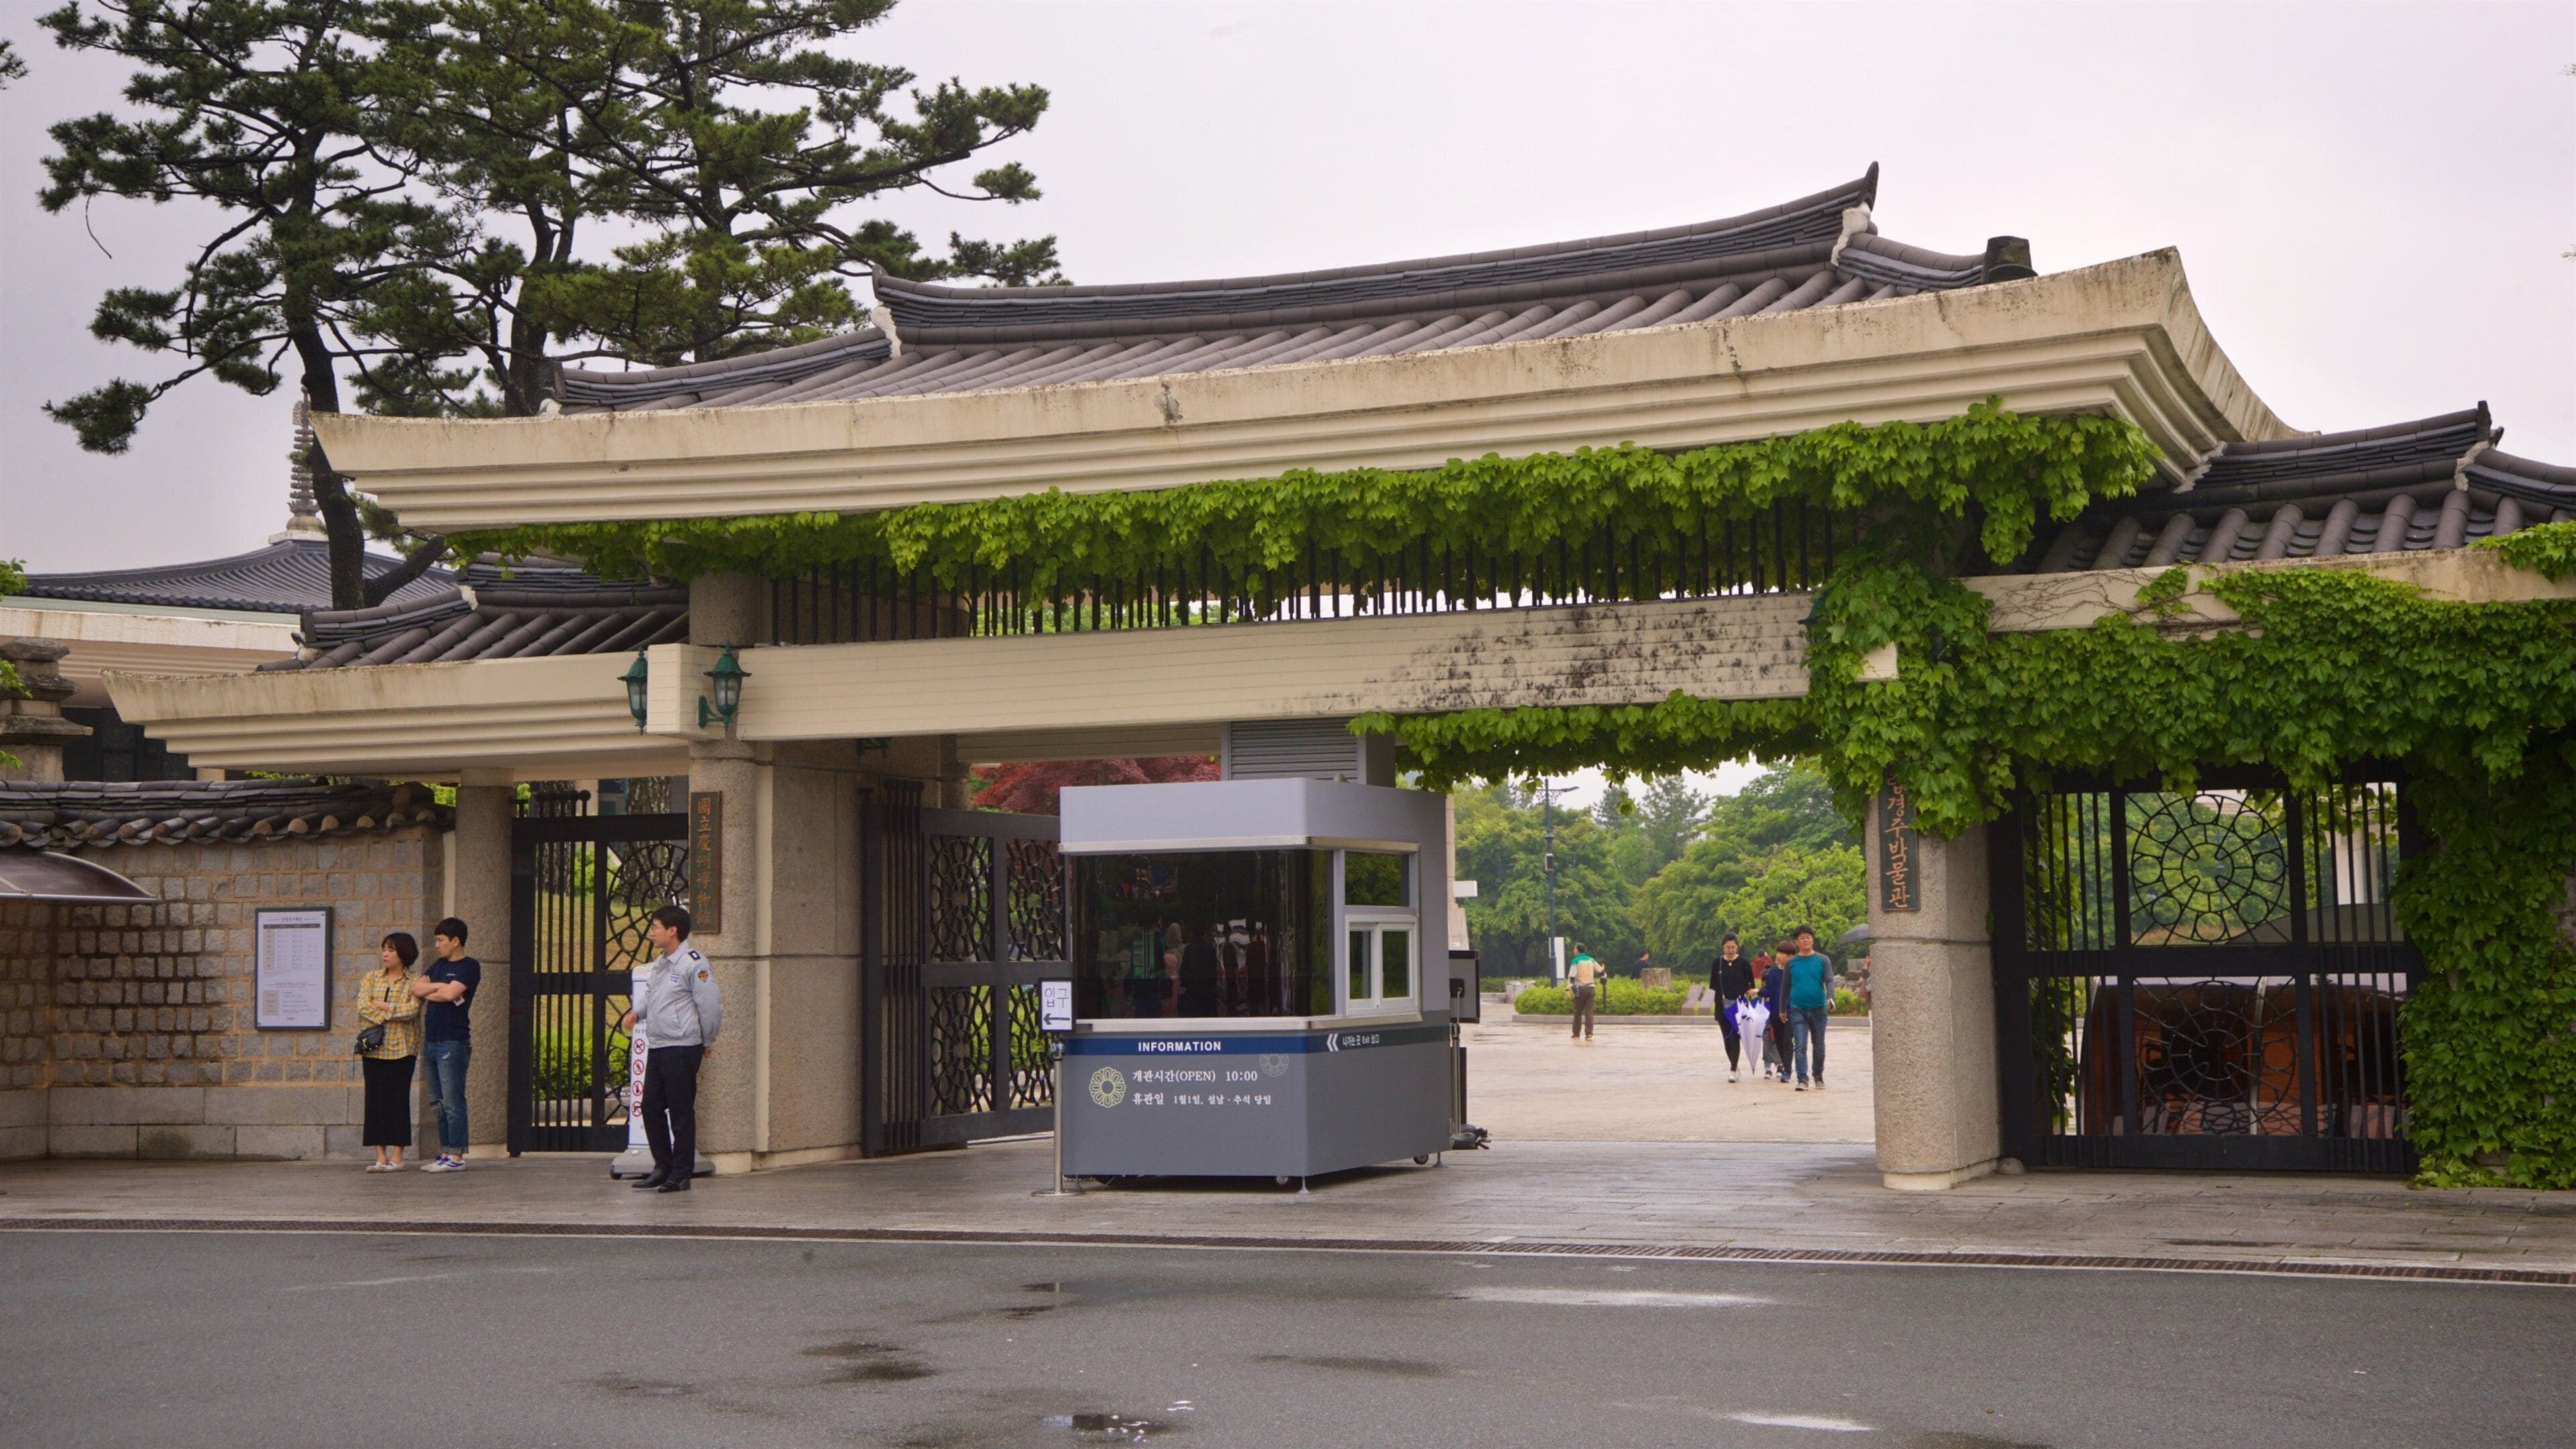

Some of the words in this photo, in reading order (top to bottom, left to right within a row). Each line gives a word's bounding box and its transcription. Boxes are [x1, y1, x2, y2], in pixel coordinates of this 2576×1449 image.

[1044, 986, 1069, 1008] 입구
[1138, 1041, 1221, 1052] INFORMATION
[1362, 1036, 1370, 1044] Exit
[1132, 1070, 1216, 1083] 개관시간(OPEN)
[1226, 1071, 1257, 1081] 10:00
[1132, 1093, 1164, 1106] 휴관일
[1208, 1095, 1224, 1105] 설날
[1234, 1095, 1250, 1105] 추석
[1254, 1095, 1271, 1105] 당일
